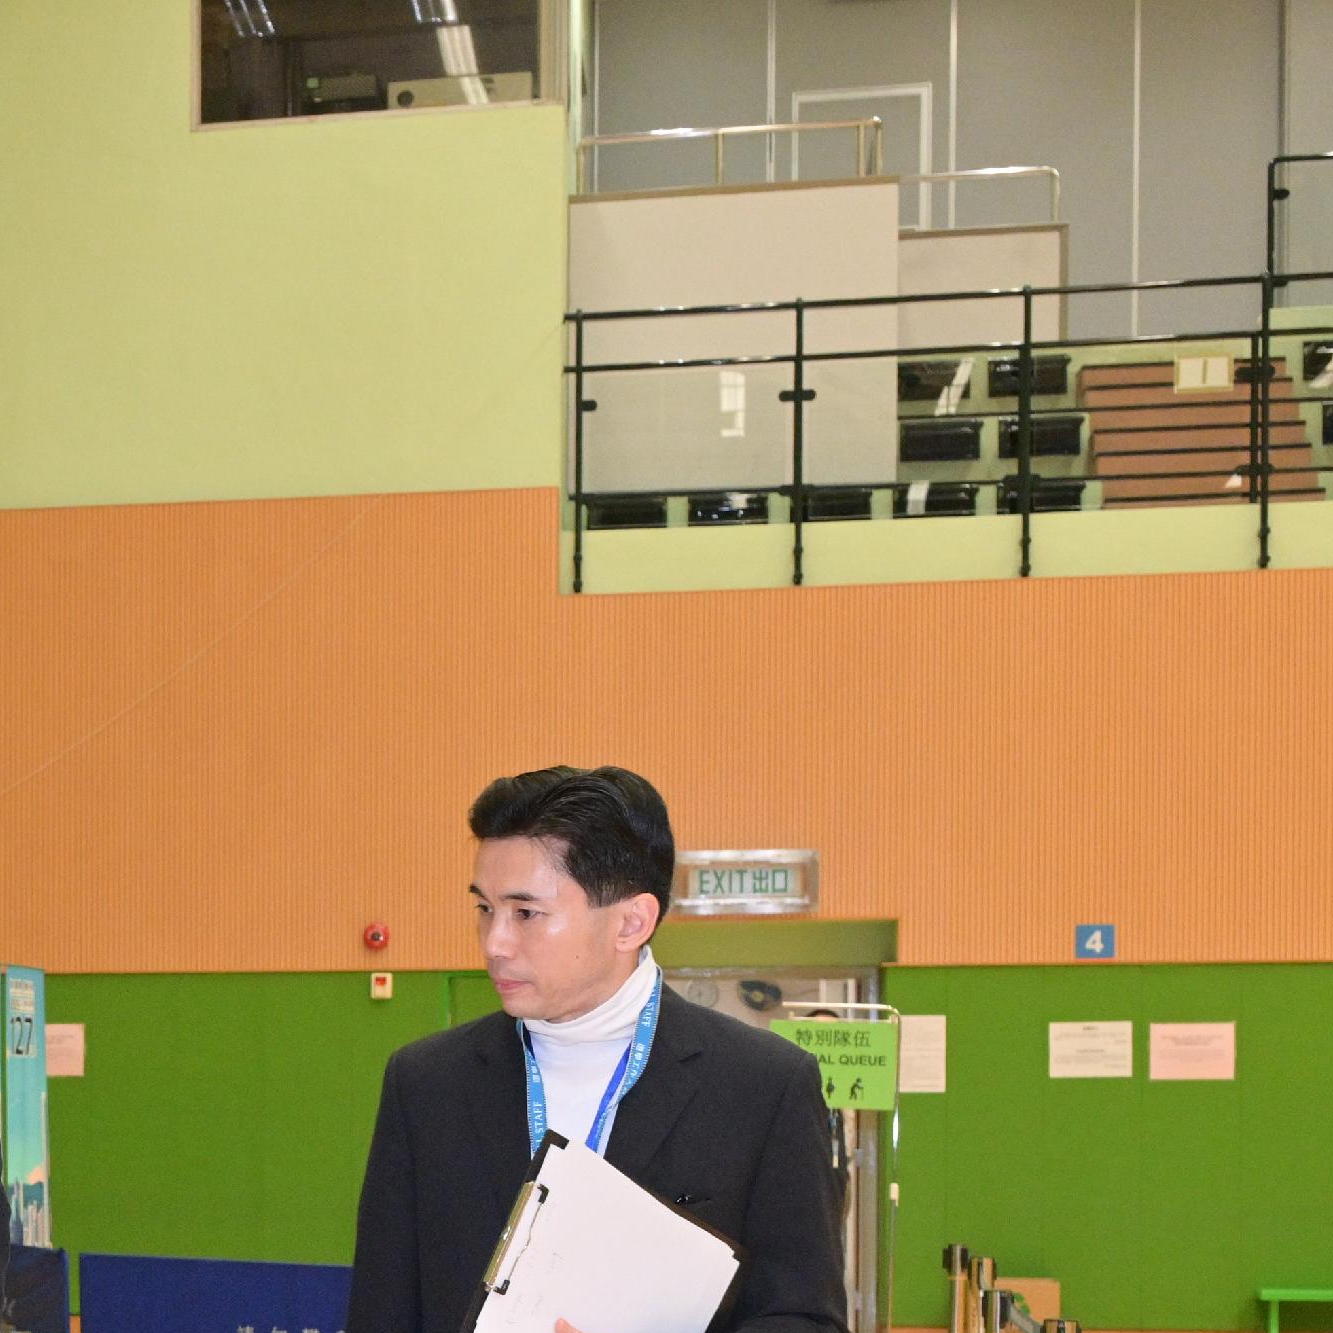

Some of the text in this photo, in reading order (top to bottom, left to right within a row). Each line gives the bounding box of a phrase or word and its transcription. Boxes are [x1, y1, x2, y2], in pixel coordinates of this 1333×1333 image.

[699, 868, 789, 894] EXIT 出口
[1084, 929, 1105, 955] 4
[795, 1028, 871, 1048] 特別隊伍
[839, 1055, 886, 1067] QUEUE
[534, 1102, 544, 1133] STAFF
